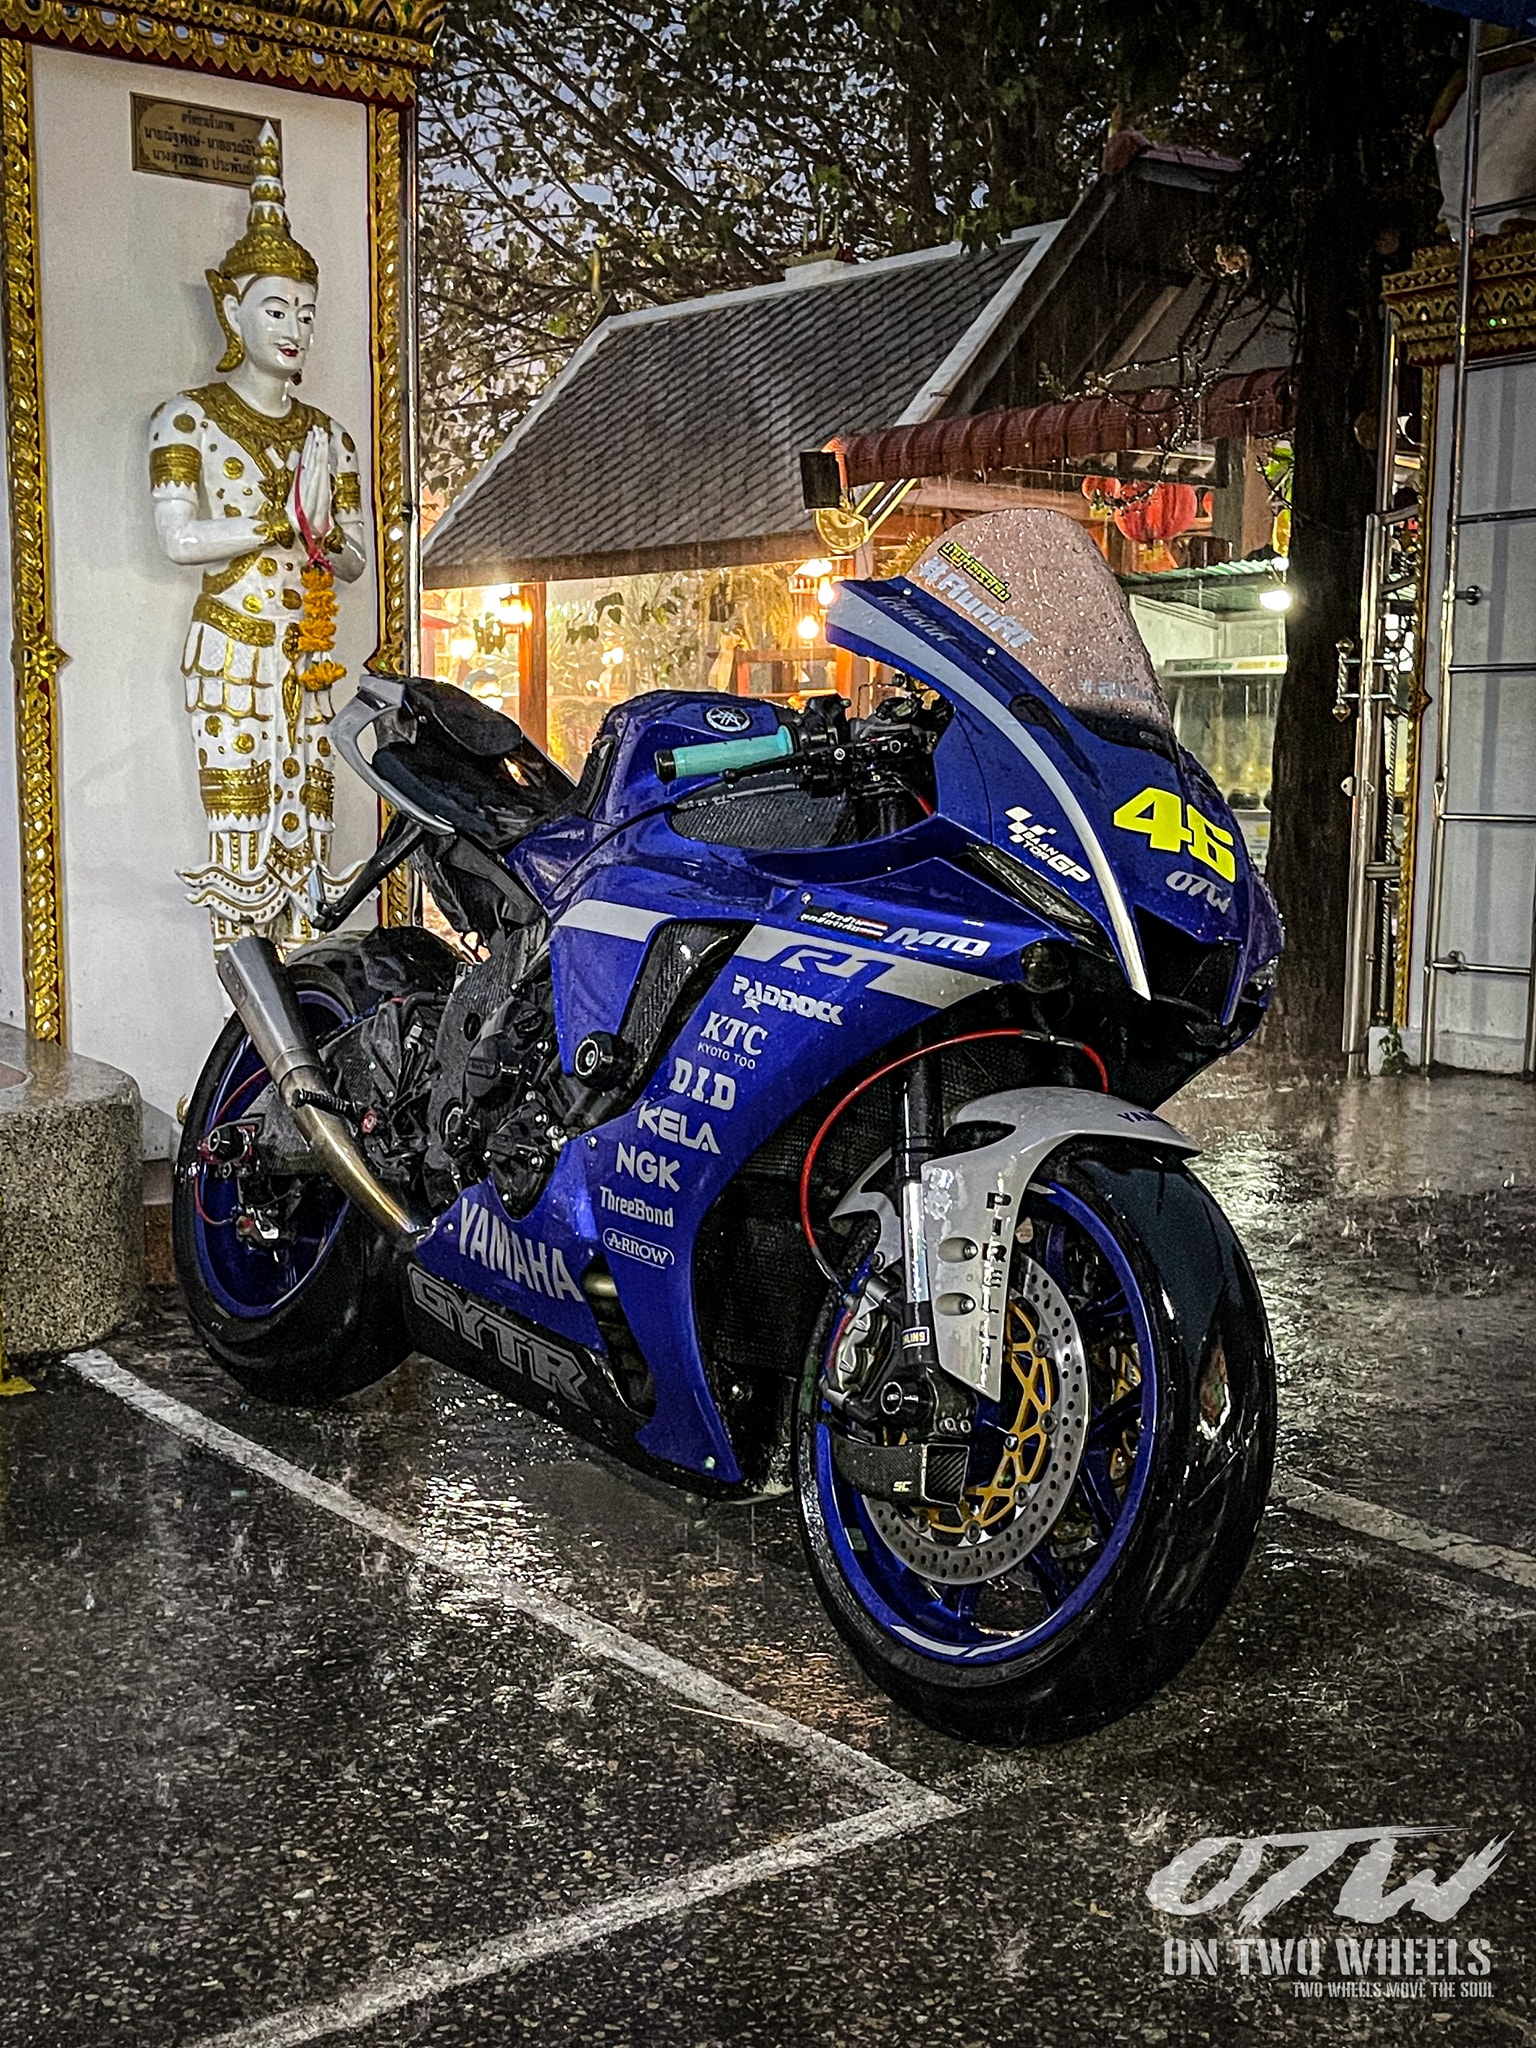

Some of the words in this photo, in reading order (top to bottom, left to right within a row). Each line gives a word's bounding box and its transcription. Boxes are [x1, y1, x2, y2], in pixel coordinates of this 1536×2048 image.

[1113, 787, 1236, 883] 46
[1046, 853, 1091, 882] GP
[697, 1041, 730, 1061] KYOTO
[700, 1010, 768, 1056] KTC
[636, 1100, 721, 1154] KELA
[615, 1141, 680, 1192] NGK
[600, 1185, 674, 1228] ThreeBond
[459, 1197, 584, 1302] YAMAHA
[607, 1232, 668, 1265] ARROW
[407, 1262, 591, 1411] GYTR
